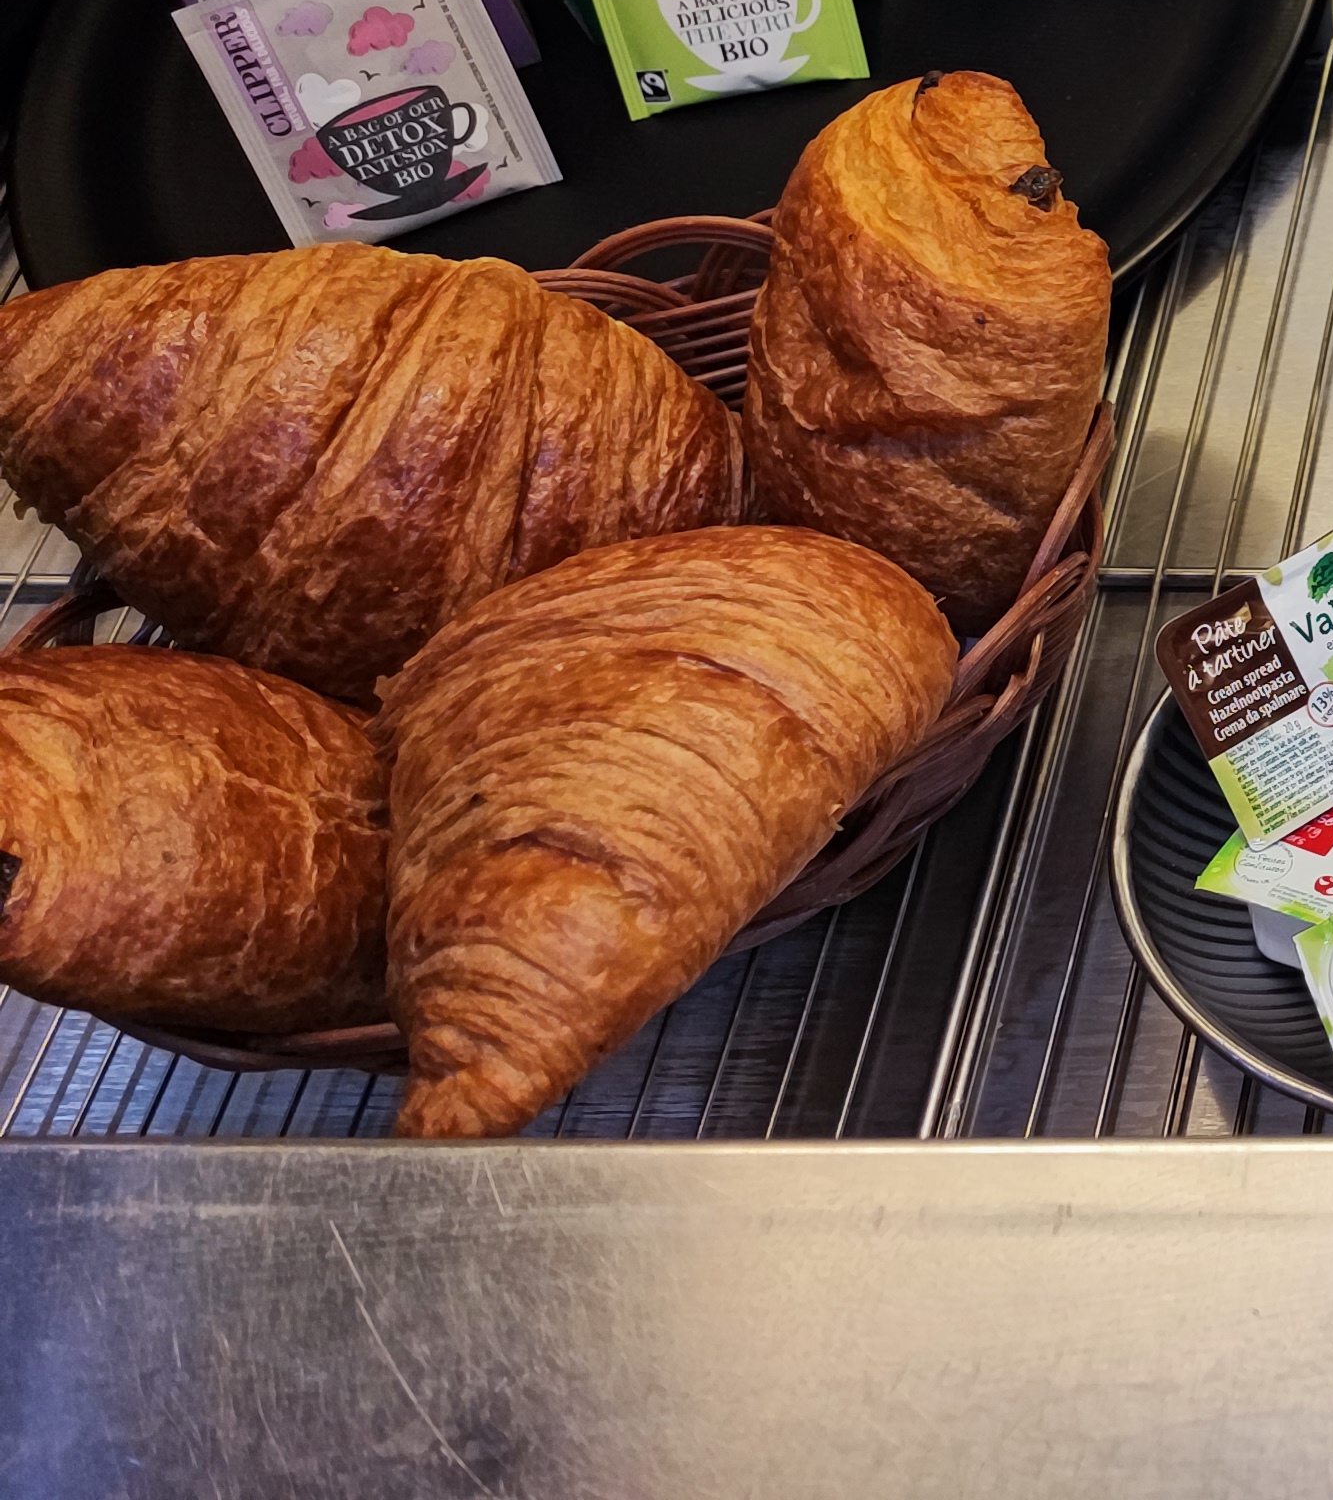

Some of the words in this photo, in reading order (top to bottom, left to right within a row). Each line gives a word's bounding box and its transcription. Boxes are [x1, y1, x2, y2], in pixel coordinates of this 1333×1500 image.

[719, 36, 769, 63] BIO
[735, 11, 794, 36] VERT
[215, 11, 292, 138] CLIPPER
[328, 135, 339, 149] A
[342, 119, 381, 144] BAG
[384, 111, 405, 127] OF
[408, 96, 446, 121] OUR
[339, 114, 449, 168] DETOX
[357, 138, 449, 181] INFUSION
[395, 161, 434, 189] BIO
[1191, 615, 1248, 654] Pâte
[1200, 623, 1279, 677] tartiner
[1206, 676, 1243, 706] Cream
[1244, 655, 1283, 689] spread
[1208, 668, 1297, 725] Hazelnootpasta
[1213, 711, 1249, 743] Crema
[1258, 683, 1308, 723] spalmare
